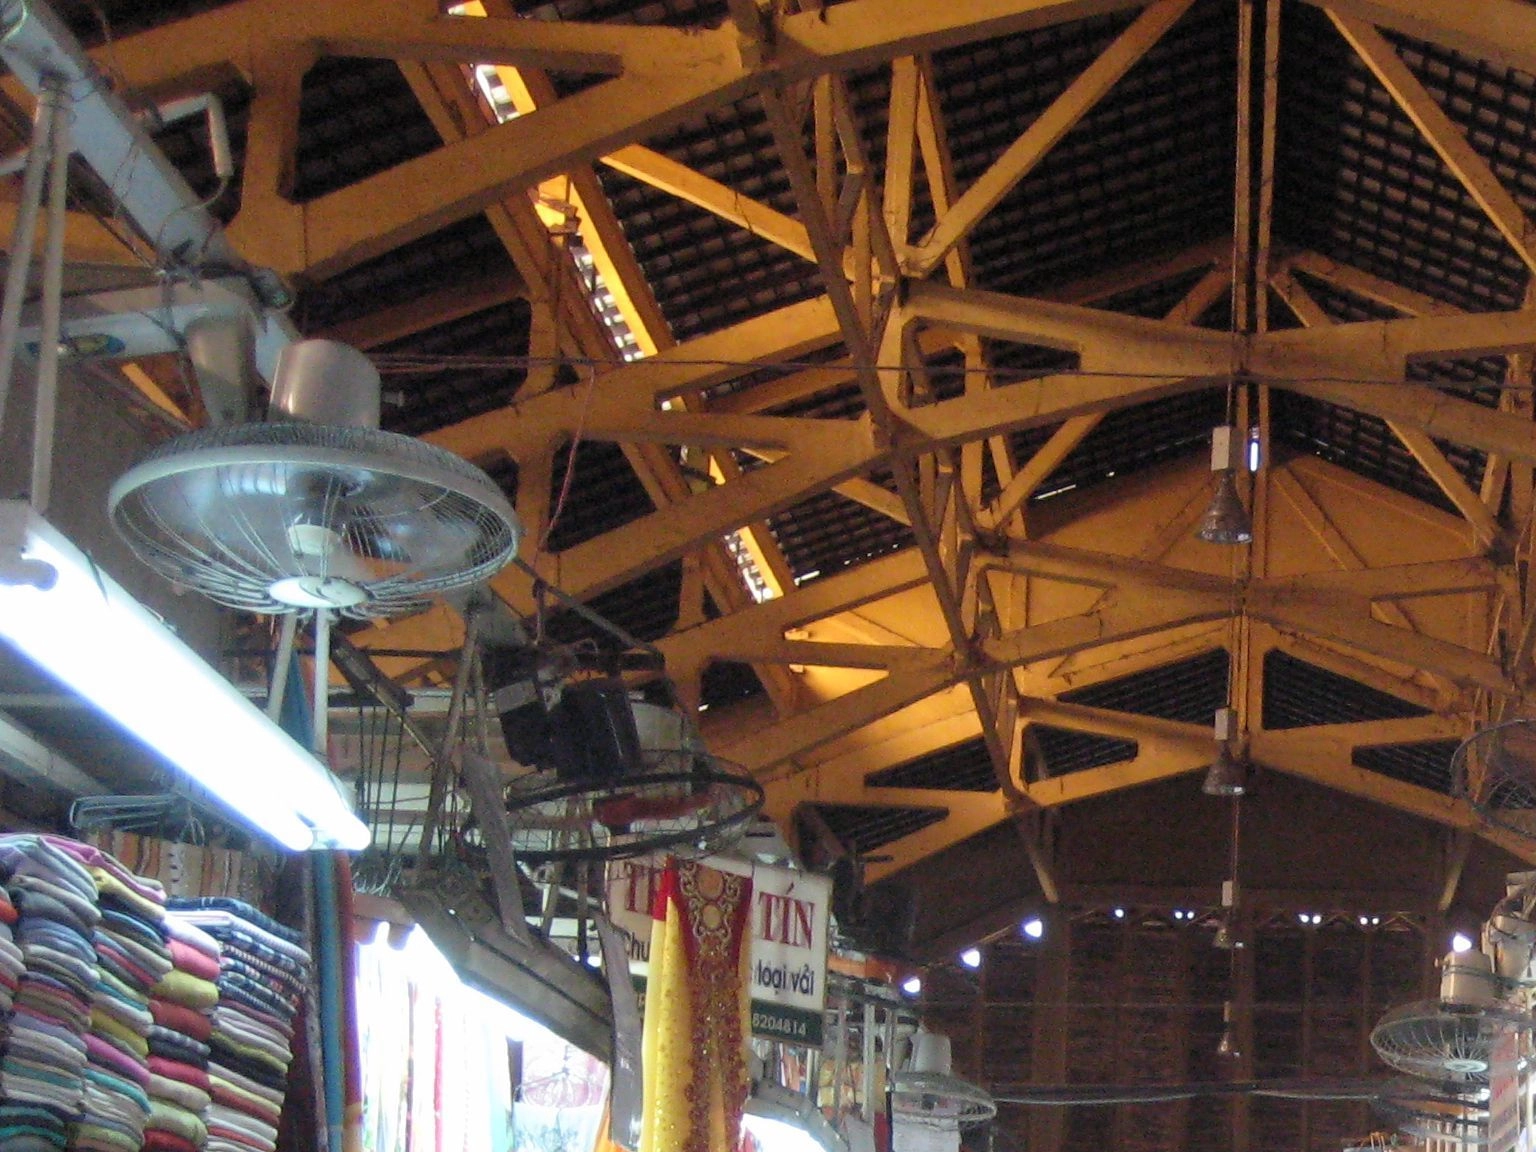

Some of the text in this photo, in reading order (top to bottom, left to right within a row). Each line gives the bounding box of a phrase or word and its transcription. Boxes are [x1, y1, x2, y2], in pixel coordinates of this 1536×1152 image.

[759, 882, 815, 950] TÍN
[758, 959, 814, 996] loại vải
